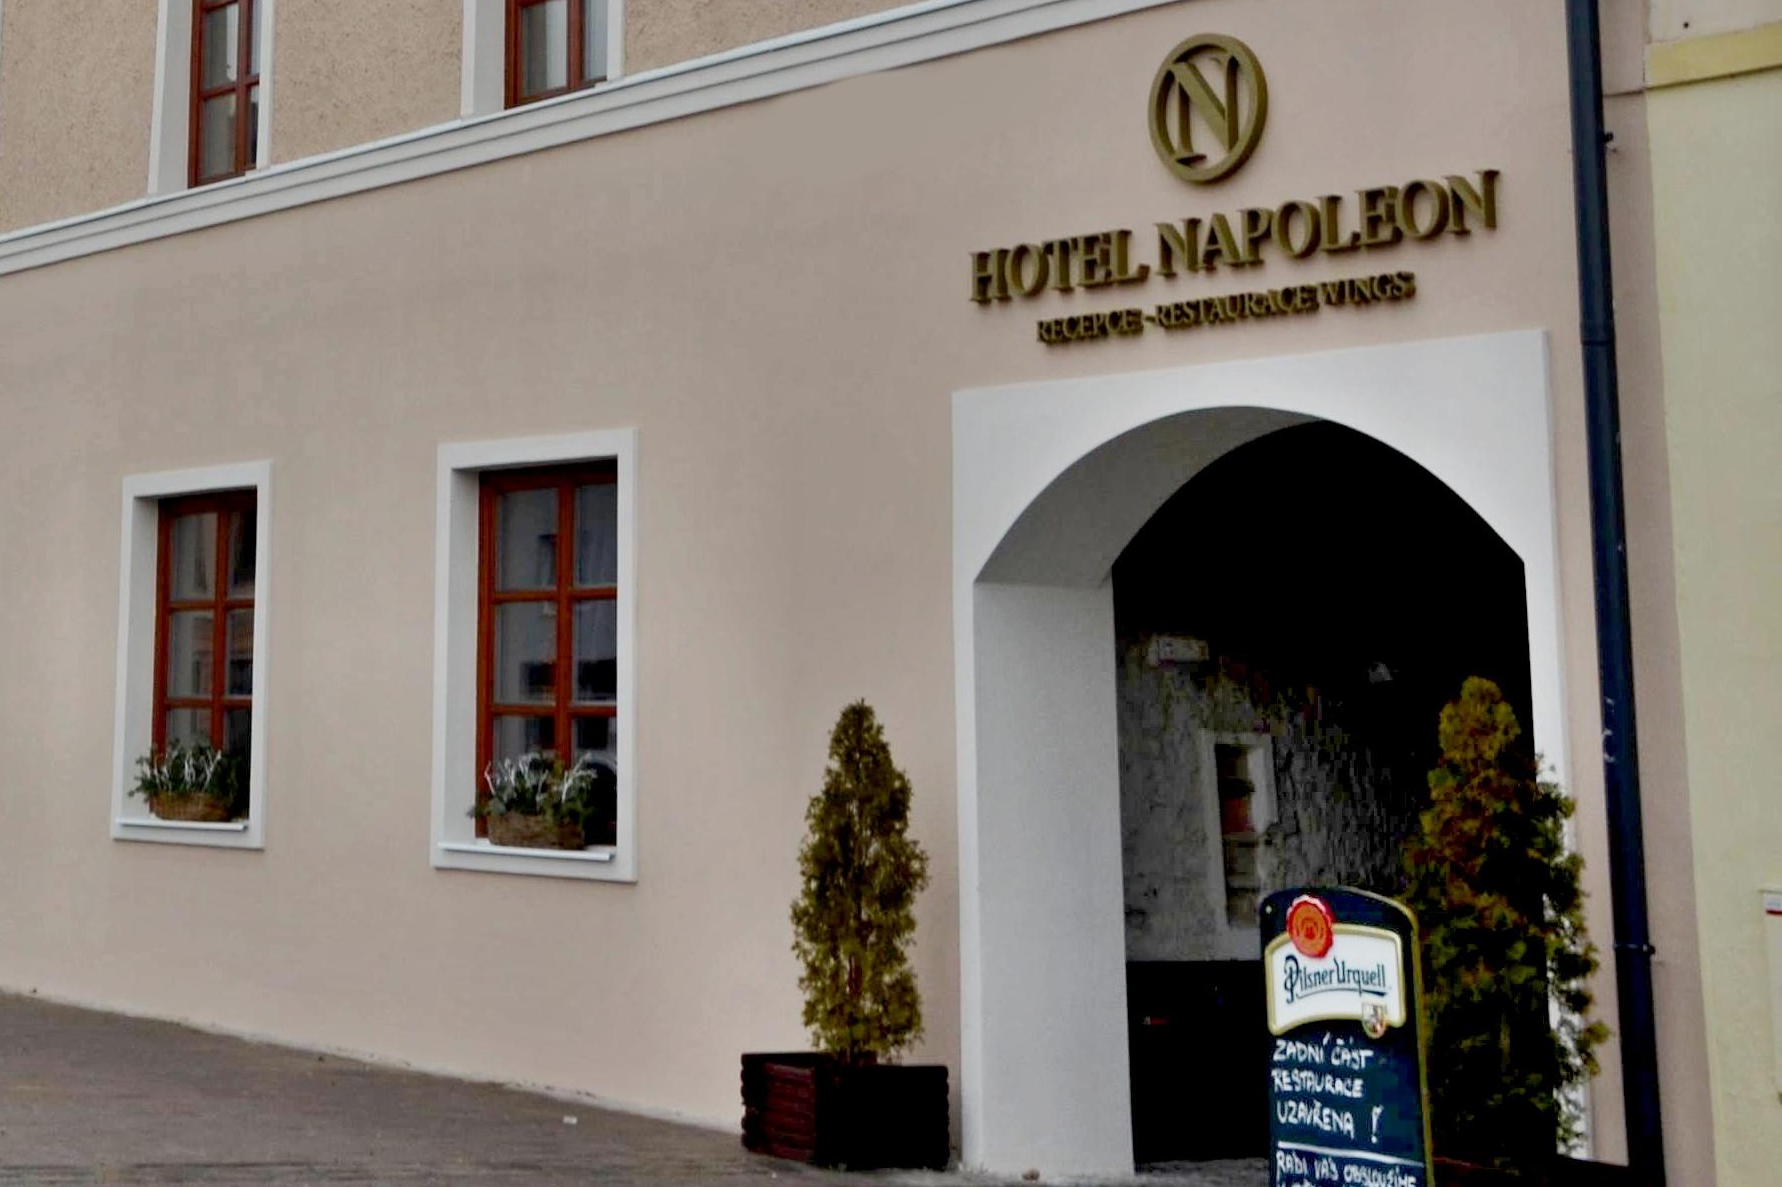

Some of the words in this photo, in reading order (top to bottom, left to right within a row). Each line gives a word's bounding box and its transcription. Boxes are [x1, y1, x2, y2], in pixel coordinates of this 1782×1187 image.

[969, 229, 1149, 304] HOTEL
[1155, 169, 1502, 282] NAPOLEON
[1037, 309, 1144, 346] RECEPCE
[1156, 284, 1319, 329] RESTAURACE
[1319, 271, 1416, 307] WINGS
[1283, 954, 1334, 1004] Pilsner
[1333, 957, 1386, 996] Urquell
[1273, 1032, 1330, 1063] ZADNÍ
[1331, 1035, 1374, 1070] ČÁST
[1271, 1068, 1364, 1098] RESTAURACE
